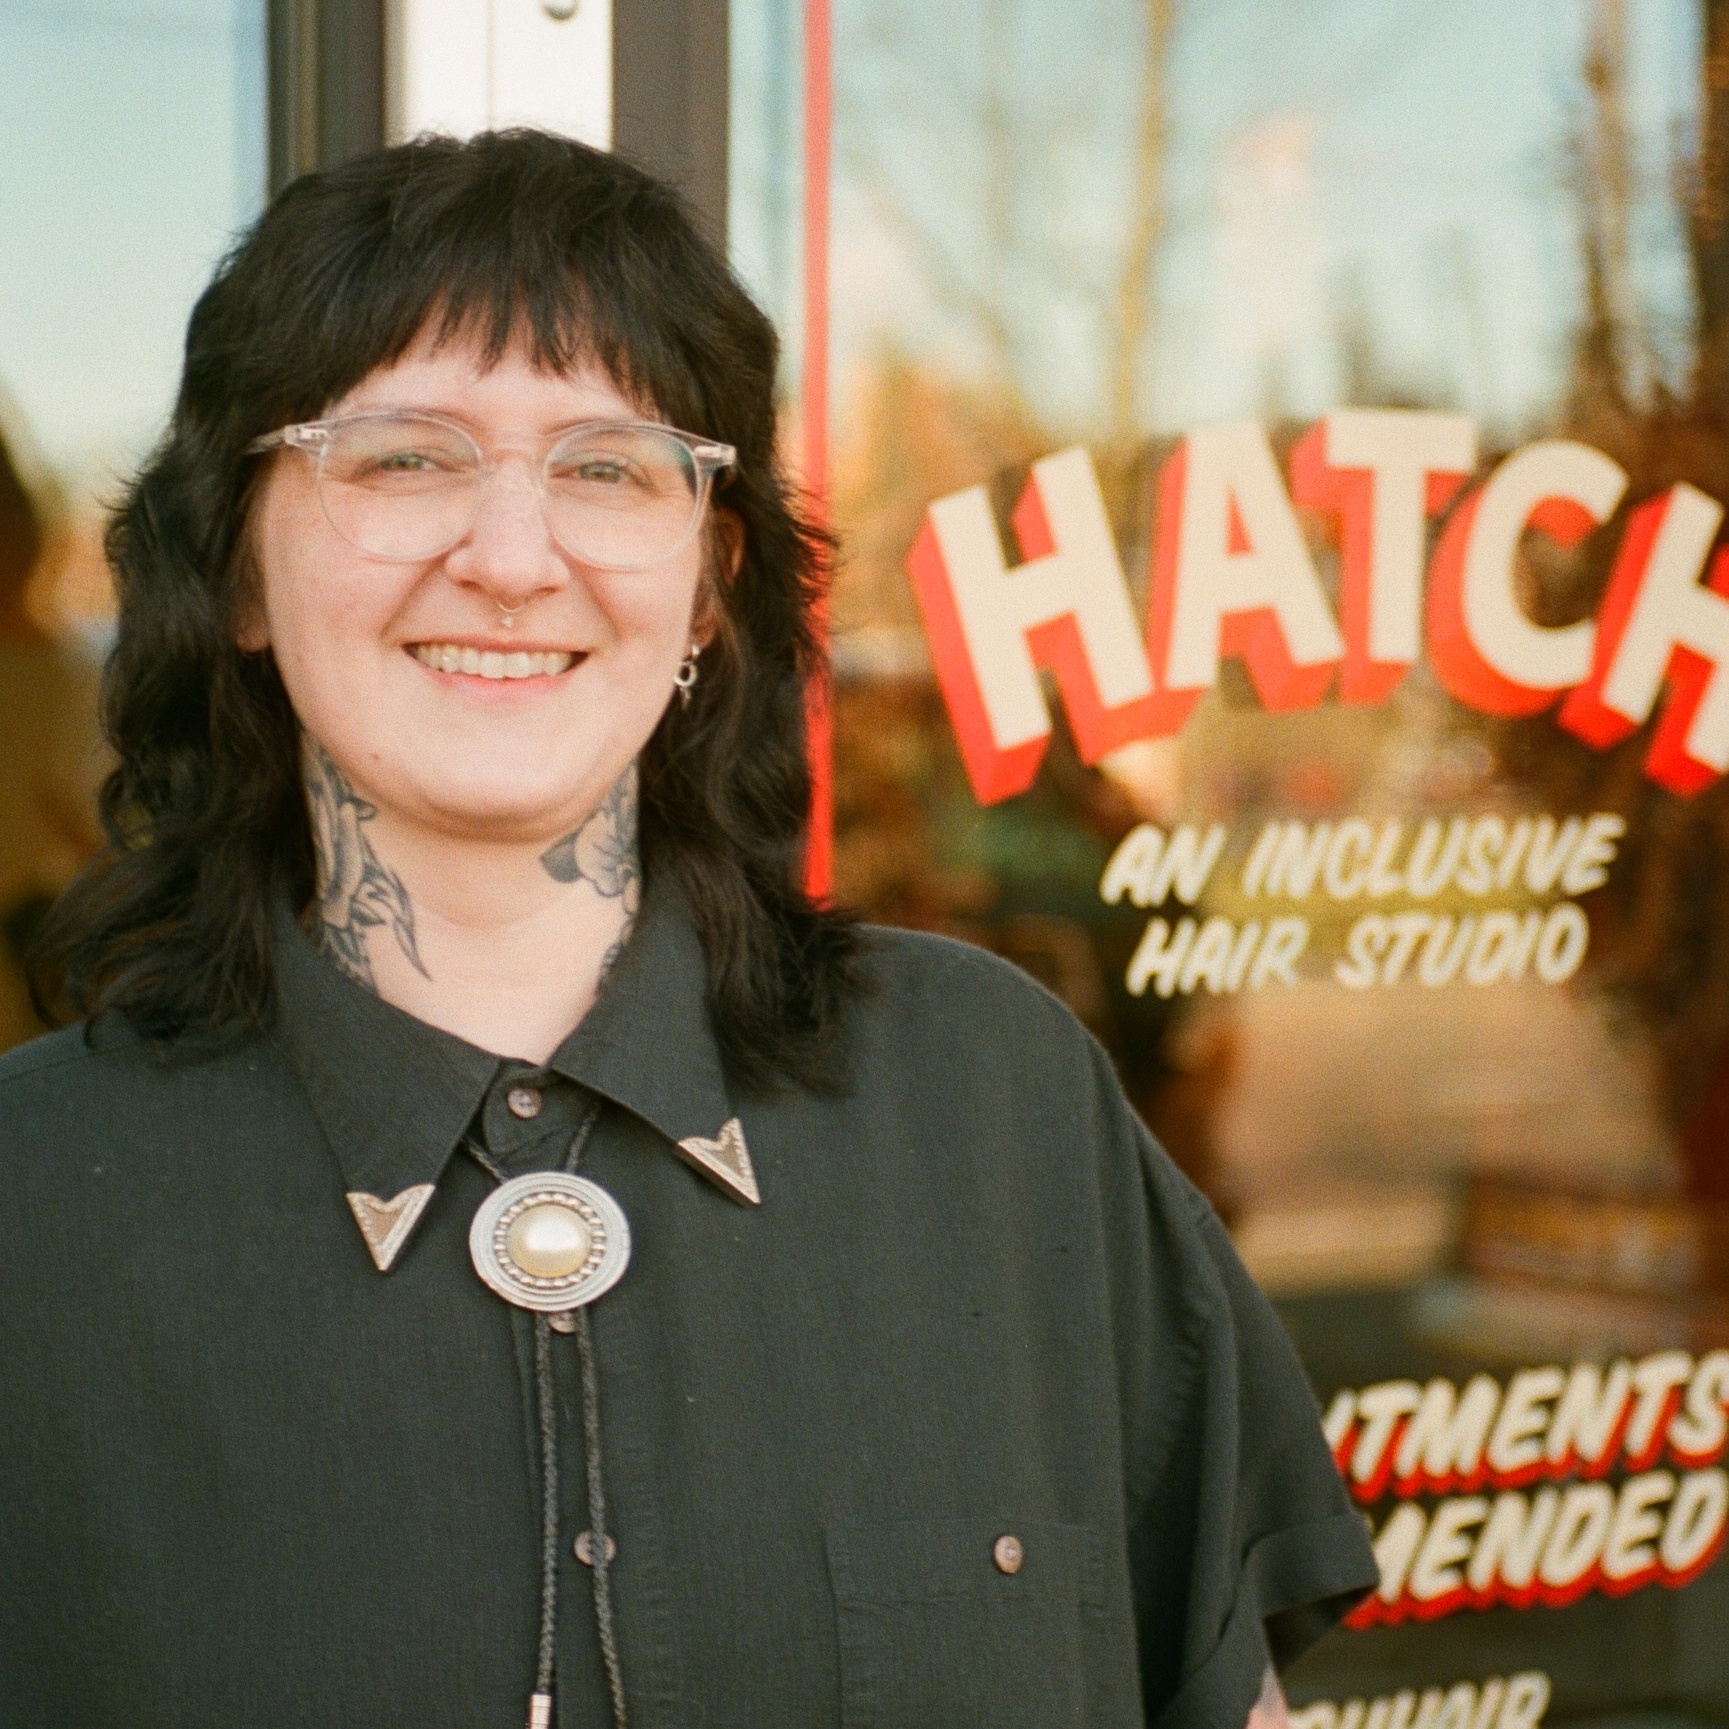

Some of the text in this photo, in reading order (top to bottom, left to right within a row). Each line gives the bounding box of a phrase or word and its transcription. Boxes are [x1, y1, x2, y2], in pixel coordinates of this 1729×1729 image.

[1101, 812, 1625, 907] AN INCLUSIVE
[1126, 902, 1590, 999] HAIR STUDIO
